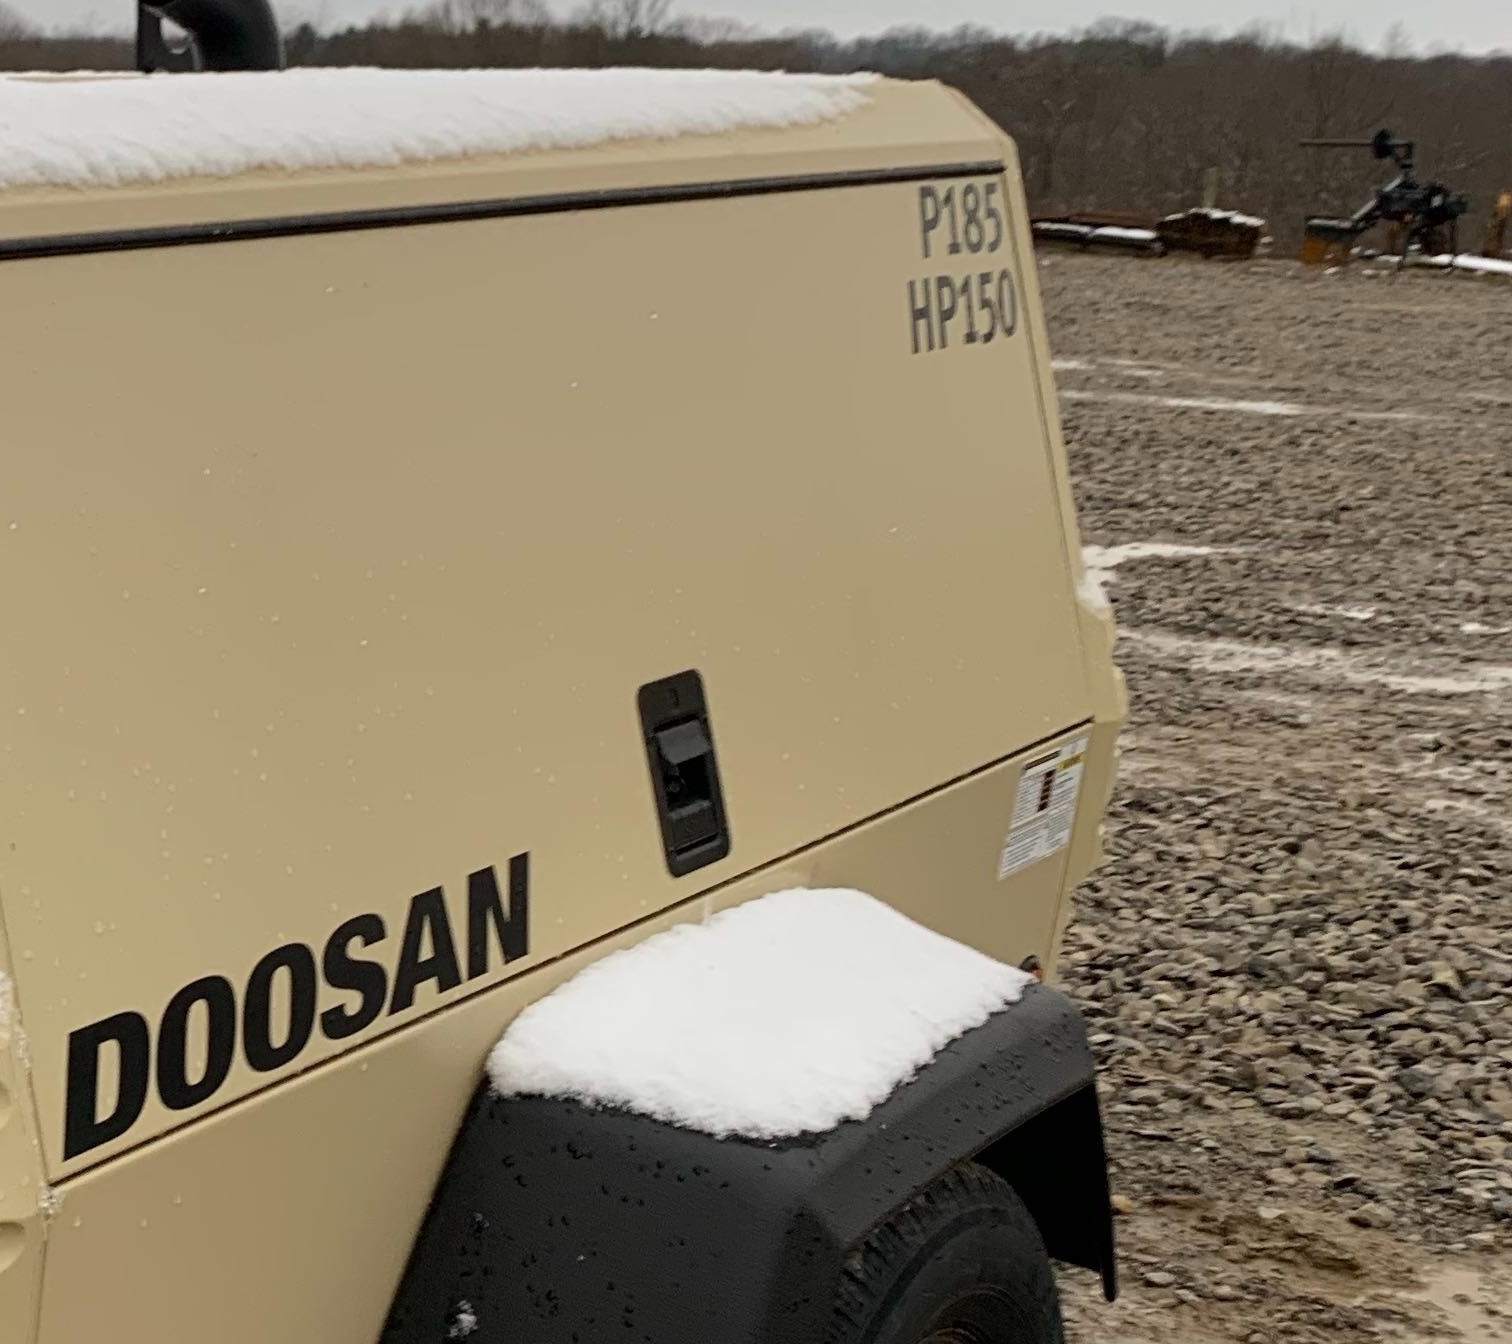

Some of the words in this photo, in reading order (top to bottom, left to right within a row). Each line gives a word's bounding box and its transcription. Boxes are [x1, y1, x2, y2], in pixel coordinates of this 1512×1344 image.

[918, 182, 1003, 258] P185
[907, 268, 1018, 354] HP150
[63, 851, 531, 1162] DOOSAN
